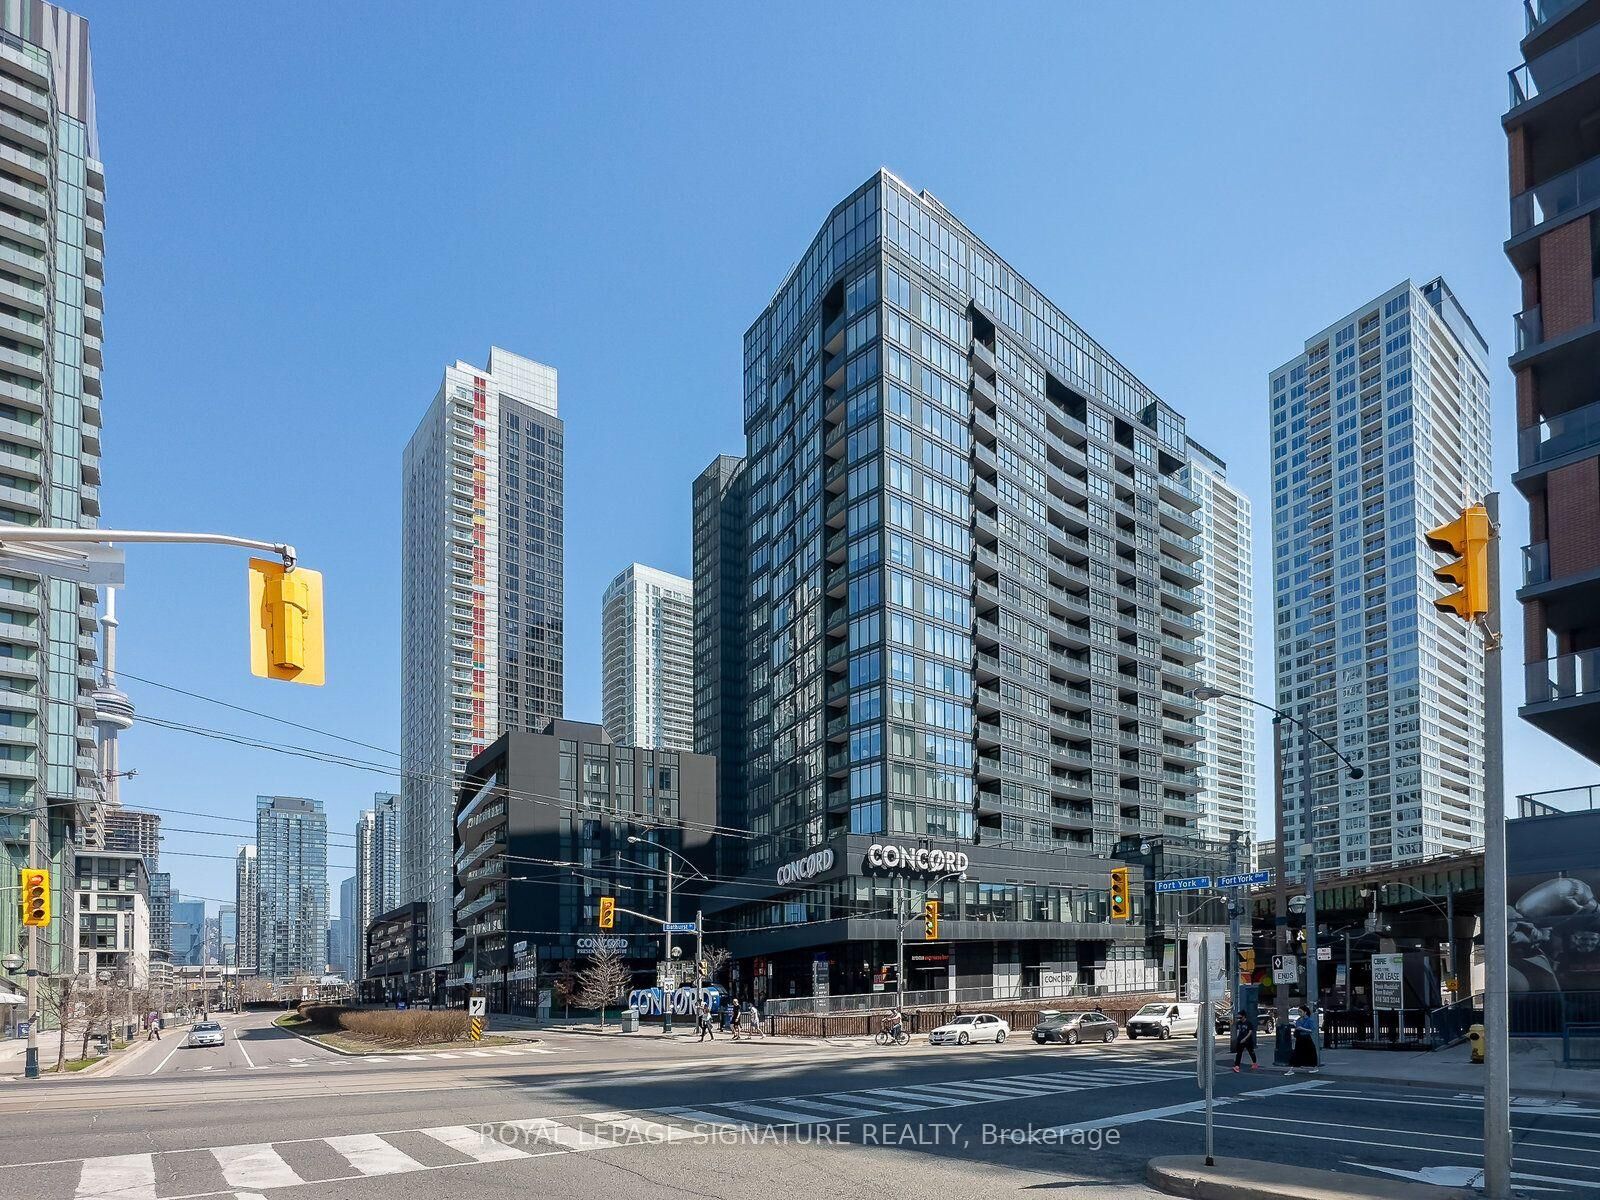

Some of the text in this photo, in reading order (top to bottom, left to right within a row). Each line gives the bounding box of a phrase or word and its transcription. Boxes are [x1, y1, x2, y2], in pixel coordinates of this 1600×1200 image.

[1221, 876, 1236, 885] Fort
[1238, 875, 1253, 883] York
[1158, 882, 1175, 890] Fort
[1179, 880, 1197, 888] York
[666, 923, 688, 931] Bathurst
[1277, 972, 1294, 980] ENDS
[1386, 972, 1400, 980] LEASE
[664, 983, 674, 991] 30
